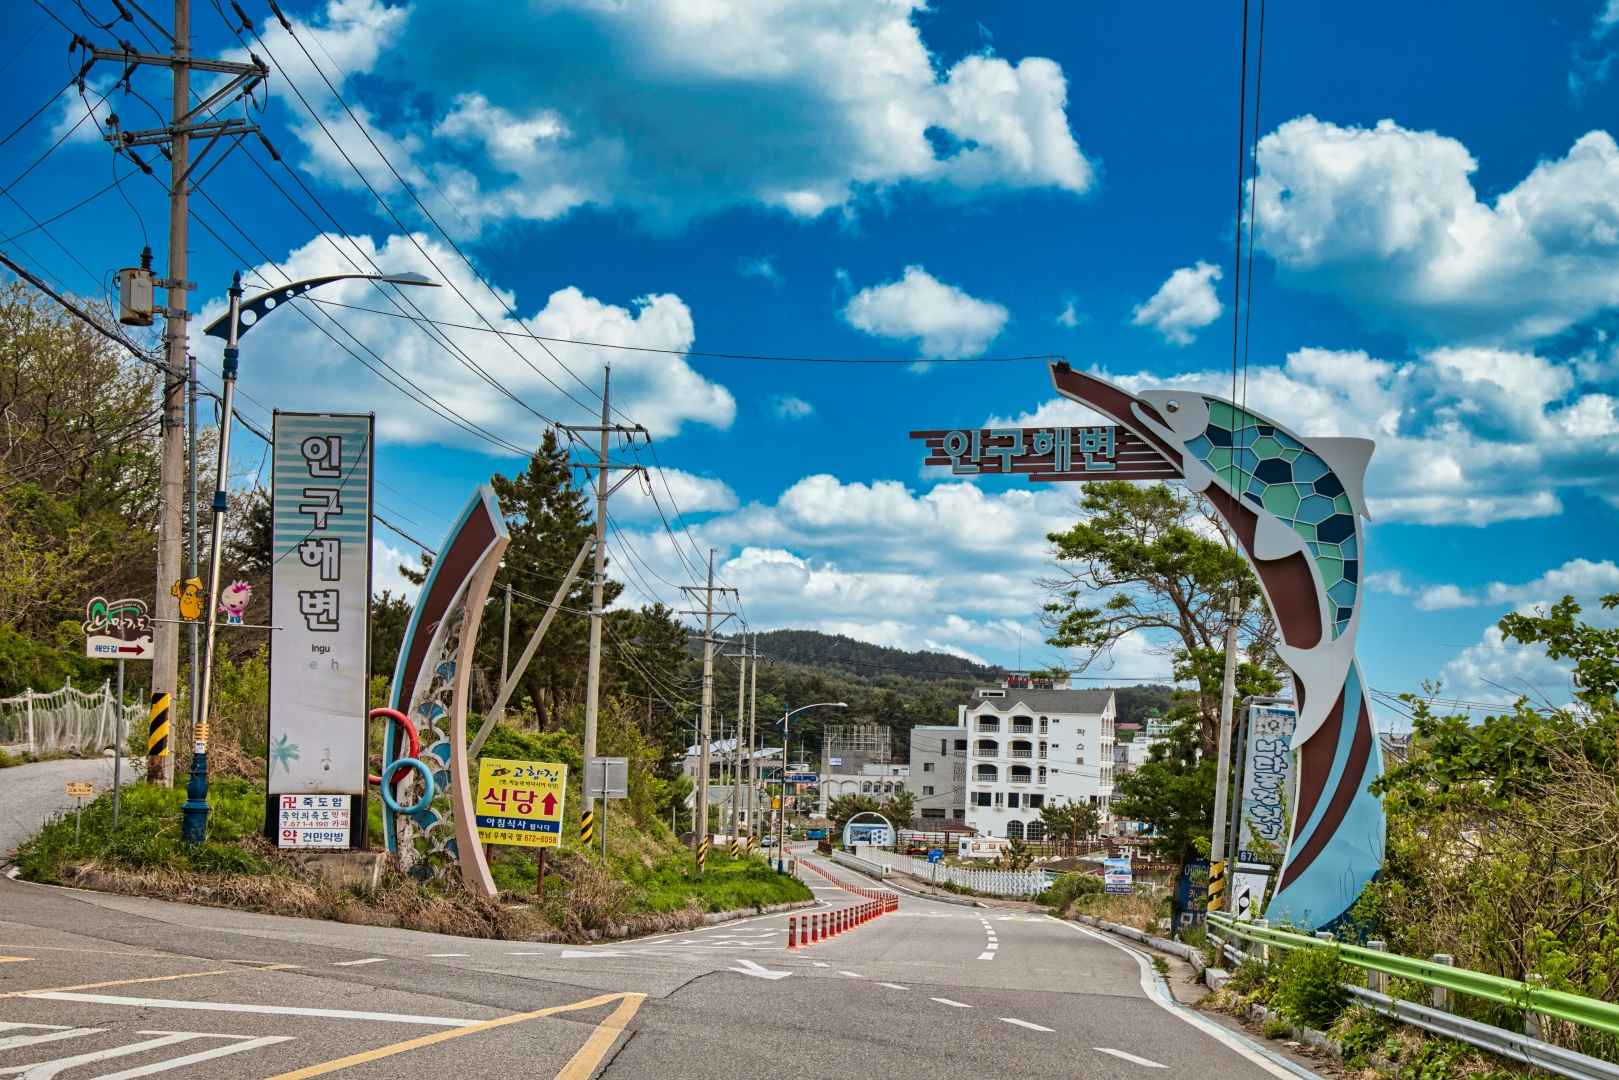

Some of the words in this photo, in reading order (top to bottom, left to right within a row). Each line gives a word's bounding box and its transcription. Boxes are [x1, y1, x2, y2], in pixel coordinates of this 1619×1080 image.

[942, 427, 1116, 474] 인구해변
[298, 435, 343, 632] 인구해변
[311, 643, 331, 655] Ingu
[483, 787, 538, 815] 식당
[486, 817, 527, 830] 아침식사
[283, 830, 298, 844] 약
